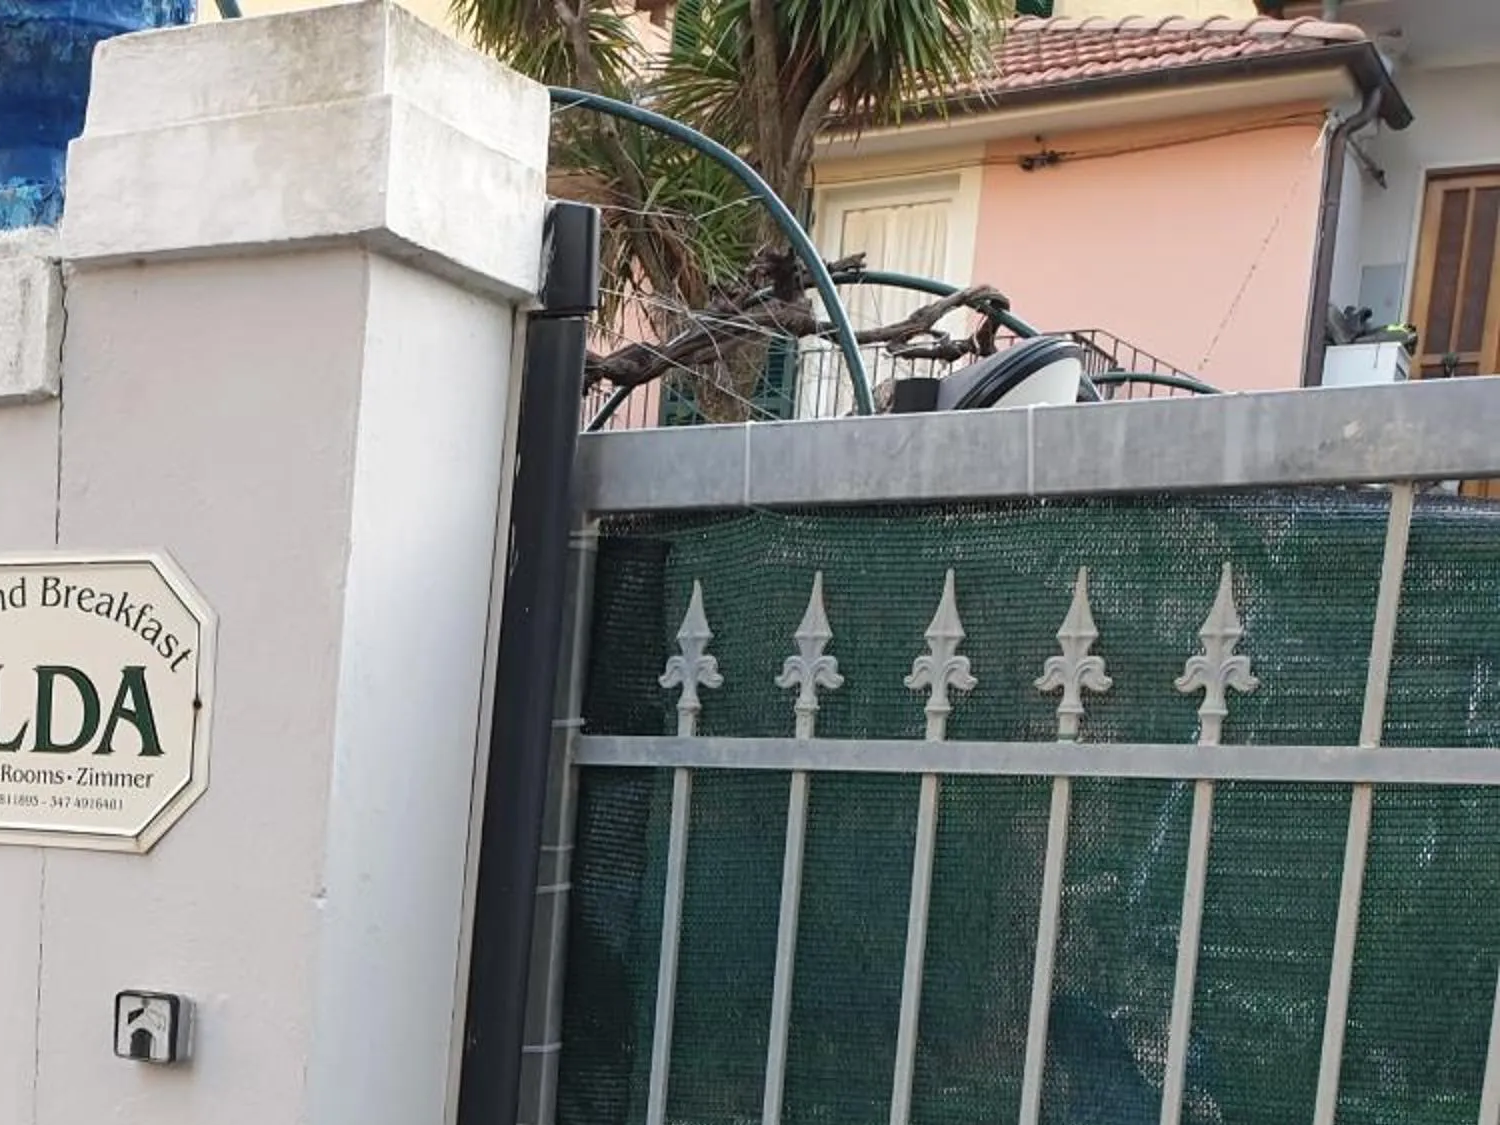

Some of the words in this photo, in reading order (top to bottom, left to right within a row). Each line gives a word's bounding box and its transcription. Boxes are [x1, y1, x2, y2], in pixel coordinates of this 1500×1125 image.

[40, 576, 192, 673] Breakfast
[1, 764, 64, 785] Rooms
[76, 767, 154, 789] Zimmer
